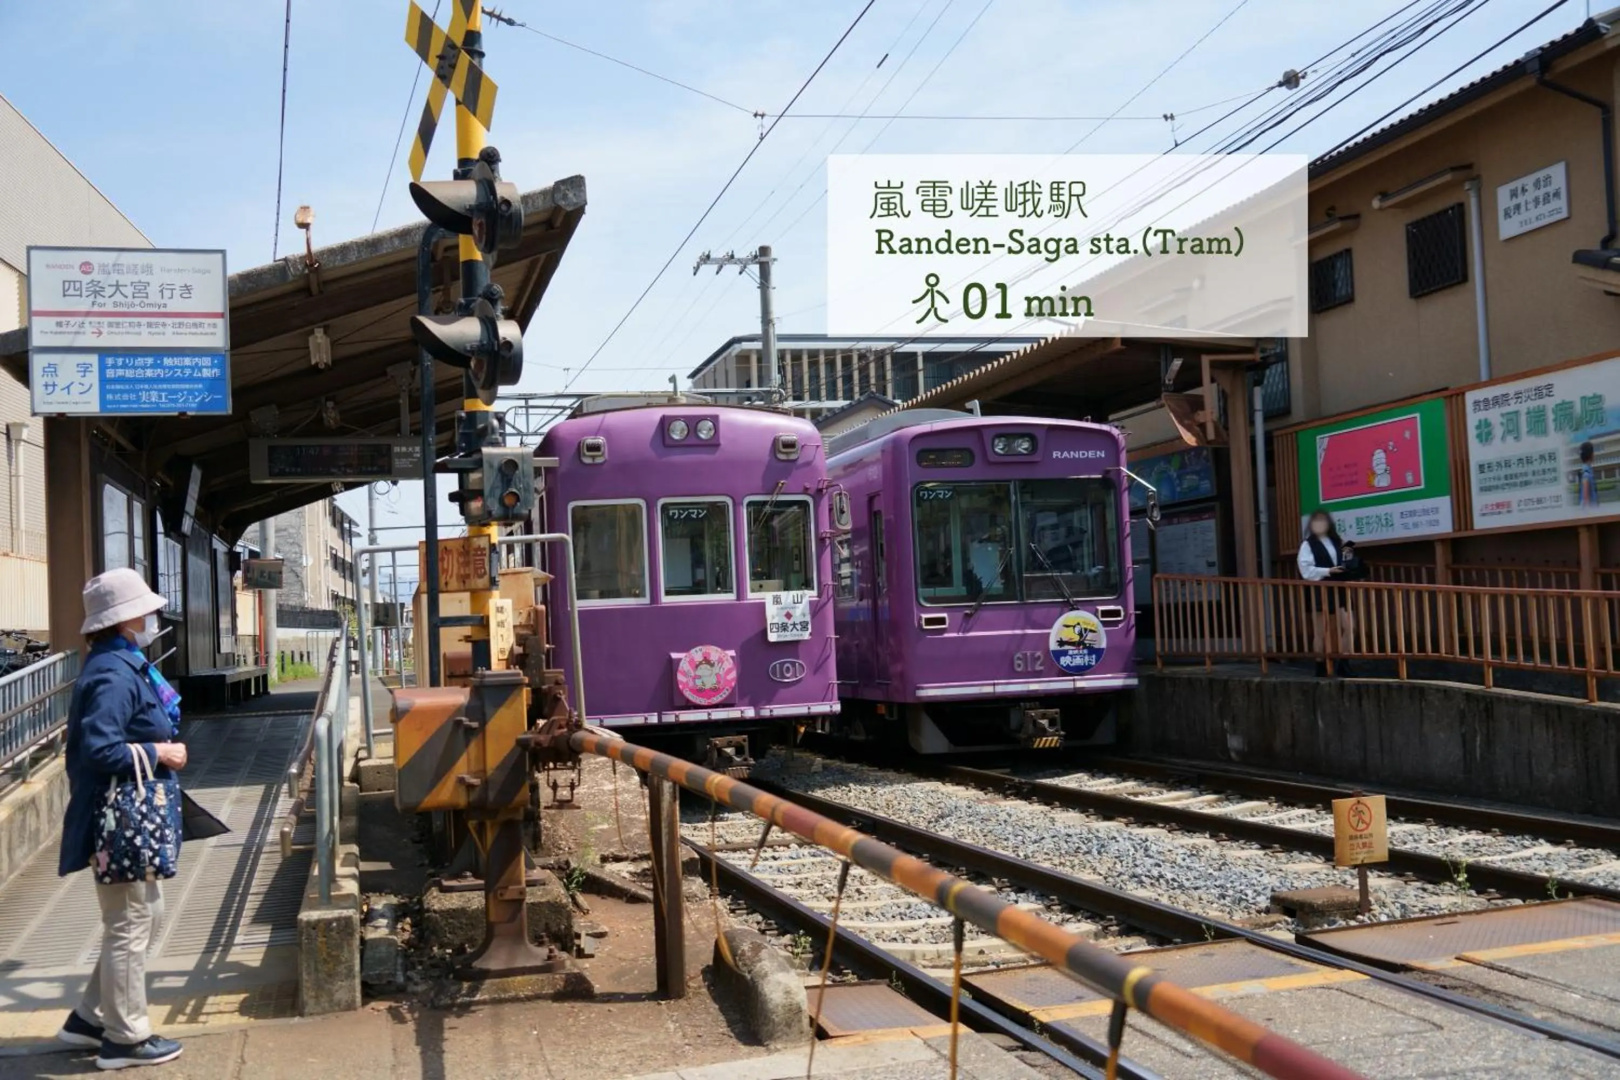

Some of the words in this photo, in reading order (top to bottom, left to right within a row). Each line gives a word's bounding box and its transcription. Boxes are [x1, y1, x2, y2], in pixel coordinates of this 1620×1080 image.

[1503, 187, 1562, 220] 税理士事務所
[62, 279, 151, 299] 四条大宮
[158, 282, 195, 300] 行き
[91, 300, 107, 309] For
[43, 381, 93, 395] サイン
[1472, 383, 1554, 413] 救急病院・労災指定
[1500, 392, 1605, 441] 河端病院
[1052, 450, 1105, 459] RANDEN
[920, 490, 952, 500] ワンマン
[669, 509, 707, 519] ワンマン
[769, 621, 809, 633] 四条大宮
[1014, 650, 1044, 671] 612
[1060, 654, 1096, 666] 映画村
[776, 662, 799, 678] 101
